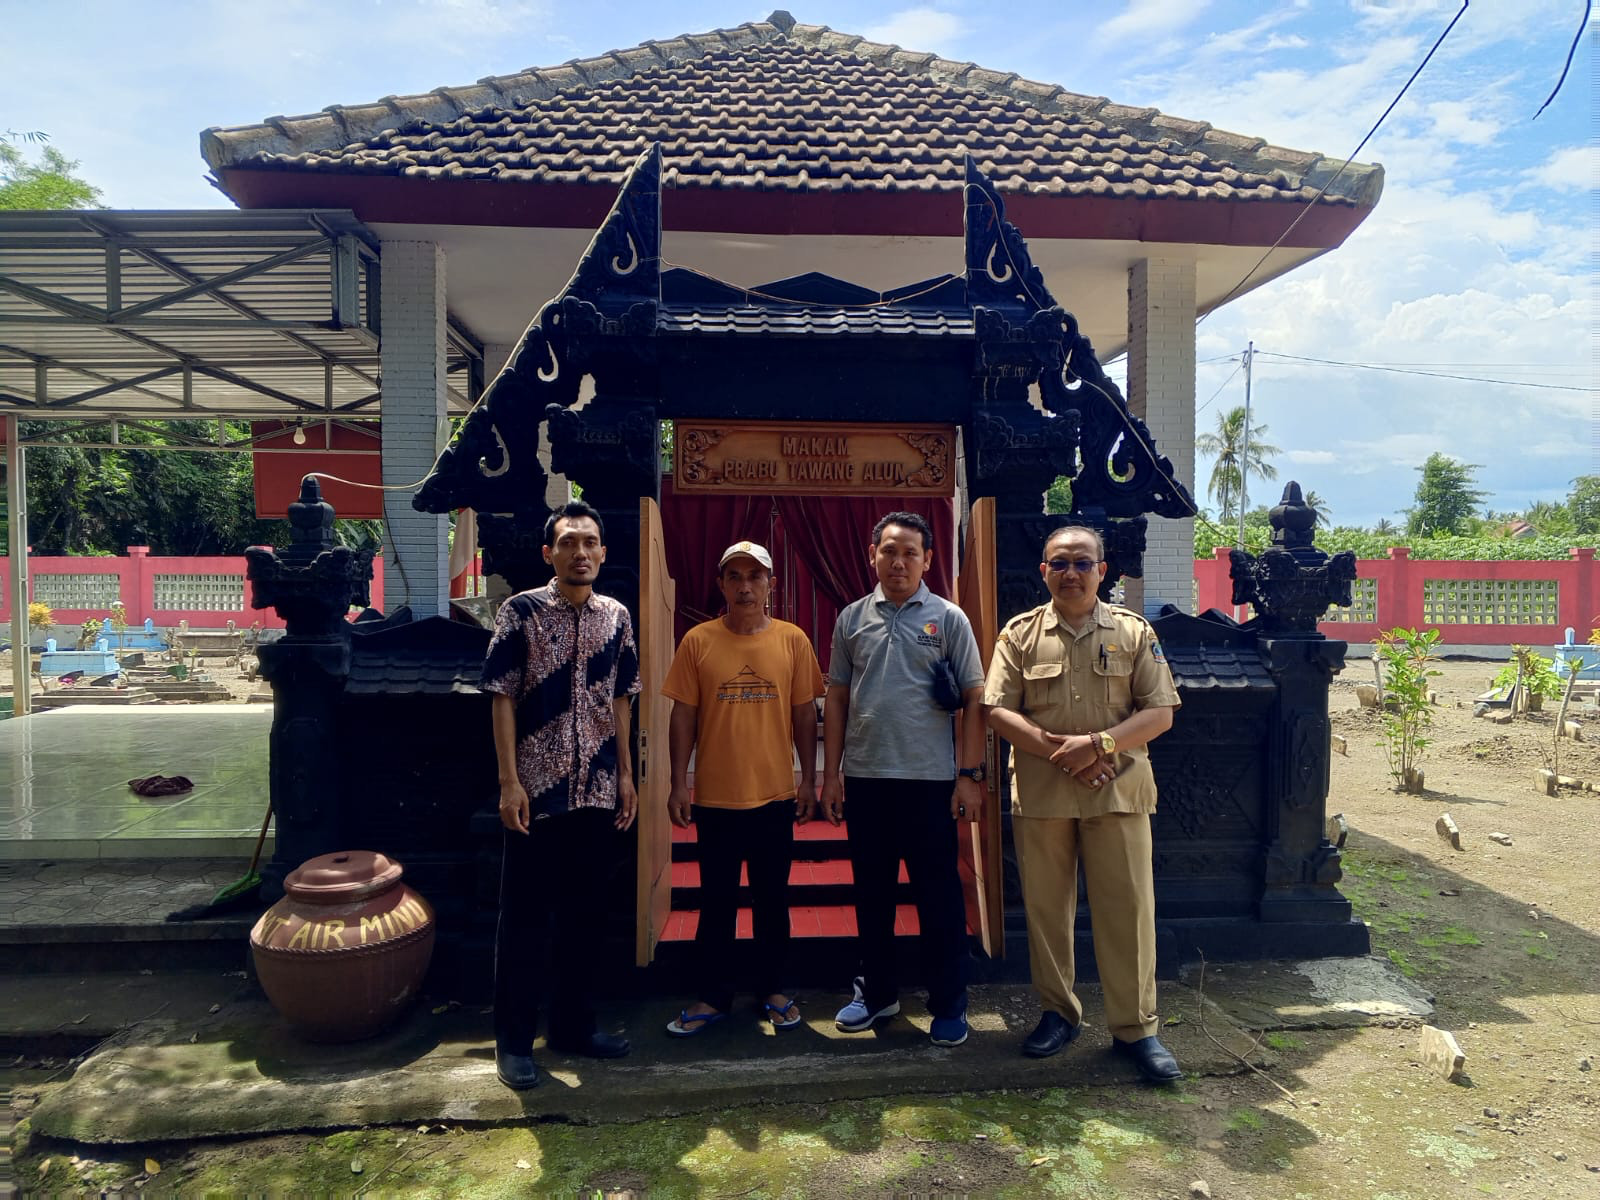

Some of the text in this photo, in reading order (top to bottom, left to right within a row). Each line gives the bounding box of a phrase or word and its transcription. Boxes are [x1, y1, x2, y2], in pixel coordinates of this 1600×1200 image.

[781, 435, 849, 457] MAKAM
[722, 459, 906, 482] PRABU TAWANG ALUN
[288, 919, 345, 949] AIR
[359, 899, 430, 944] MINU
